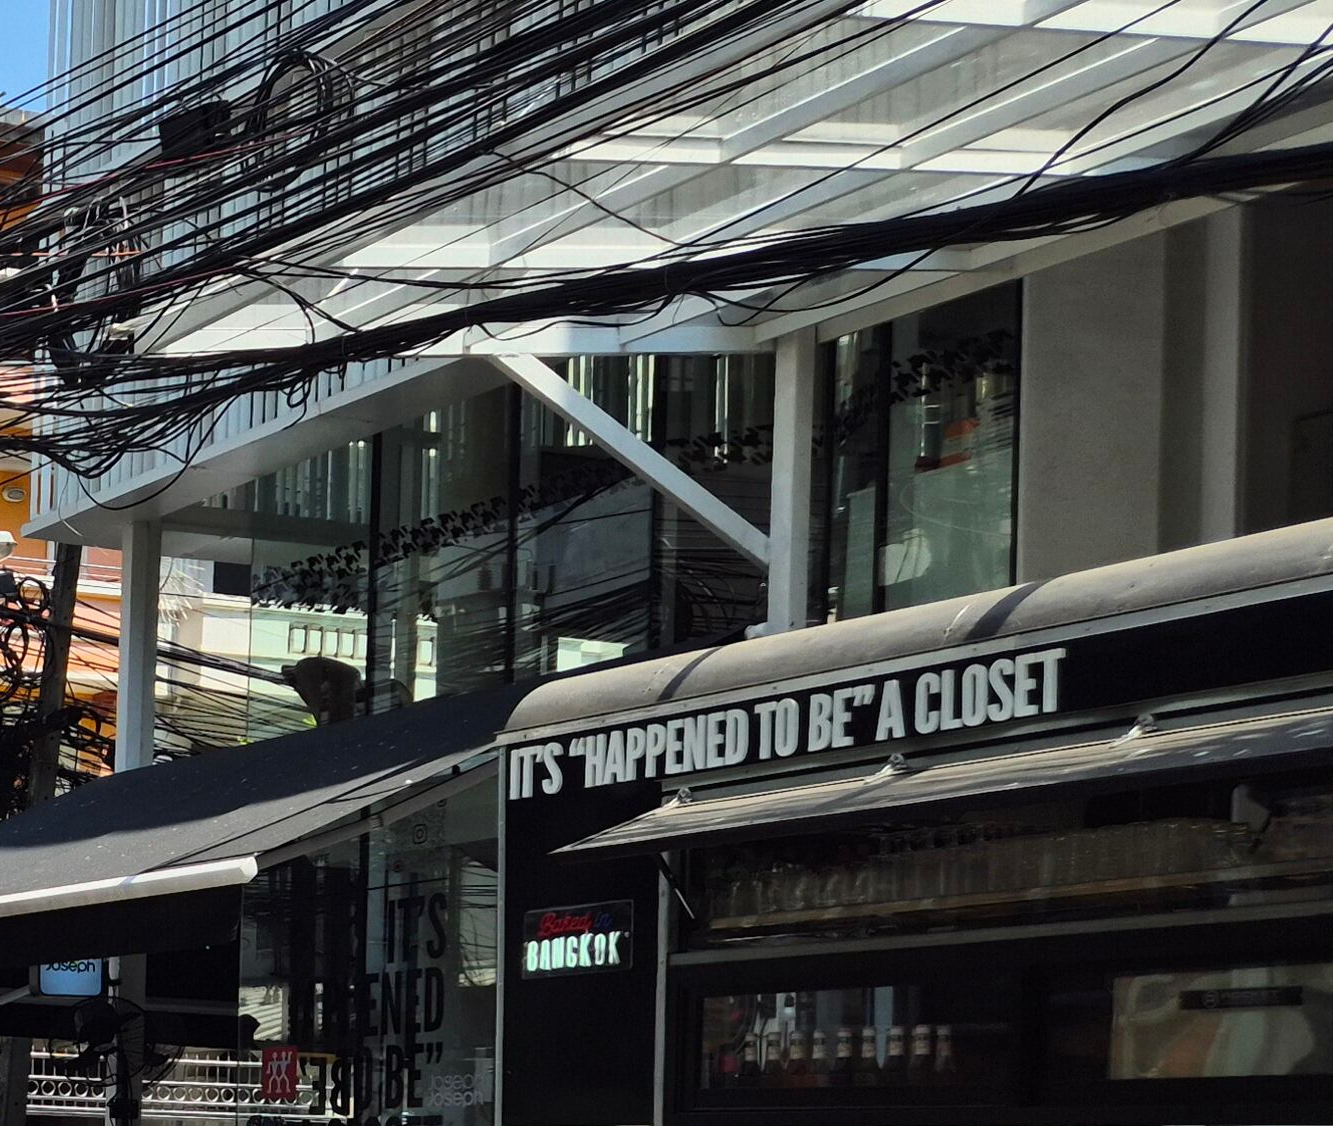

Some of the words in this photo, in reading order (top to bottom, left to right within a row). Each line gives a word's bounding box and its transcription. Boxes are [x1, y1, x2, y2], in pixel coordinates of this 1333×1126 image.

[754, 697, 798, 760] TO
[874, 679, 906, 742] A
[913, 647, 1067, 736] CLOSET
[526, 930, 621, 972] BANGKOK
